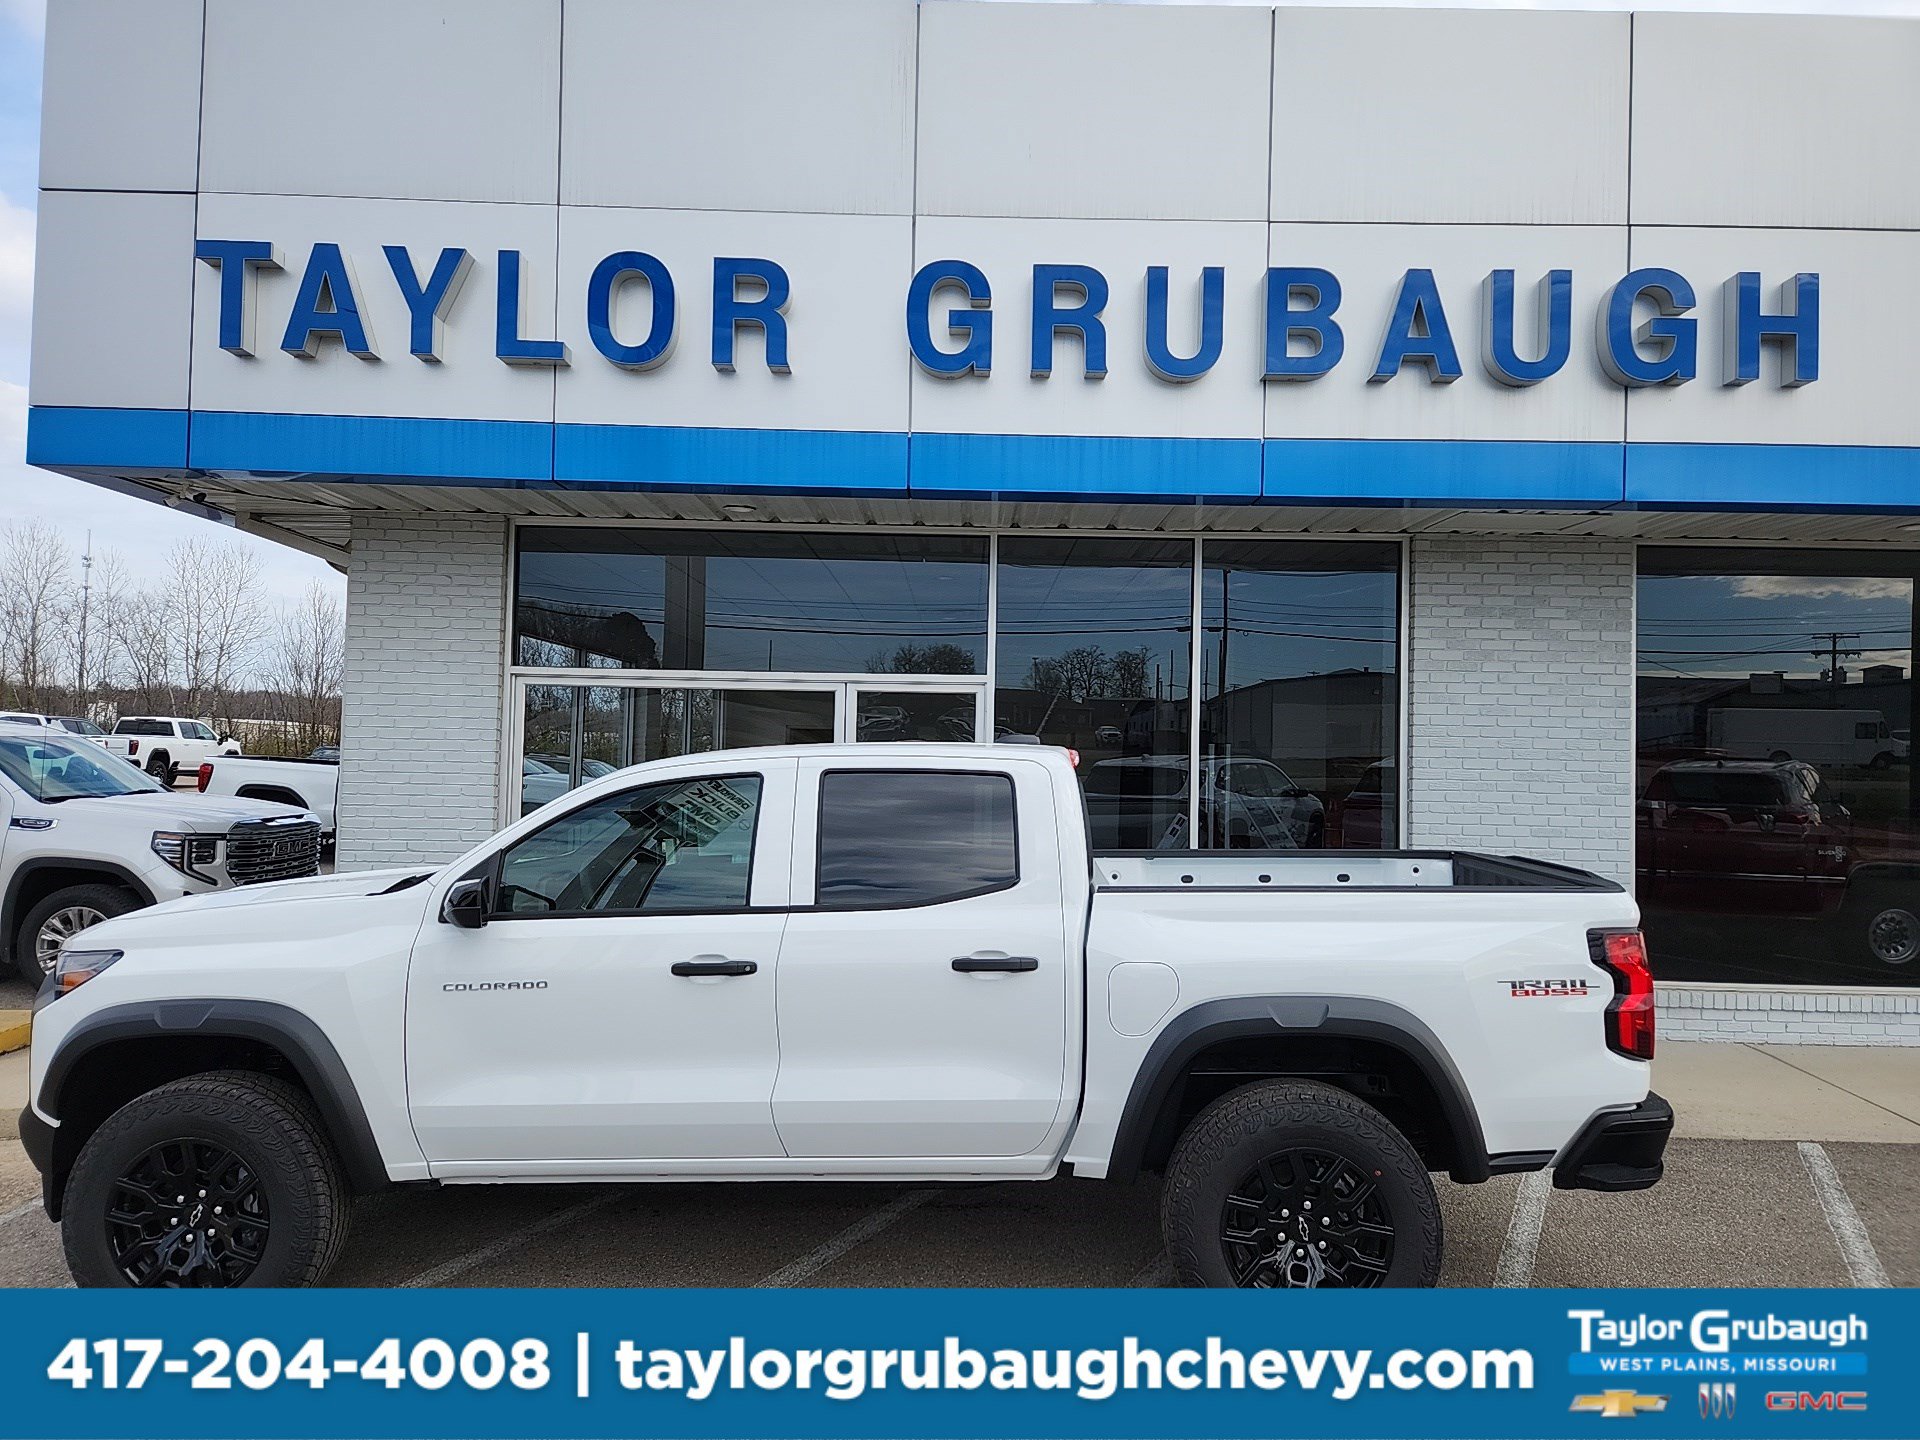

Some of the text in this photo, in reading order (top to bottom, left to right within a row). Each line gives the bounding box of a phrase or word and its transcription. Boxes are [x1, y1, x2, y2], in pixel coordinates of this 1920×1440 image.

[195, 239, 1821, 388] TAYLOR GRUBAUGH
[442, 980, 548, 992] COLORADO
[1497, 979, 1600, 990] TRAIL
[1511, 988, 1588, 997] BOSS
